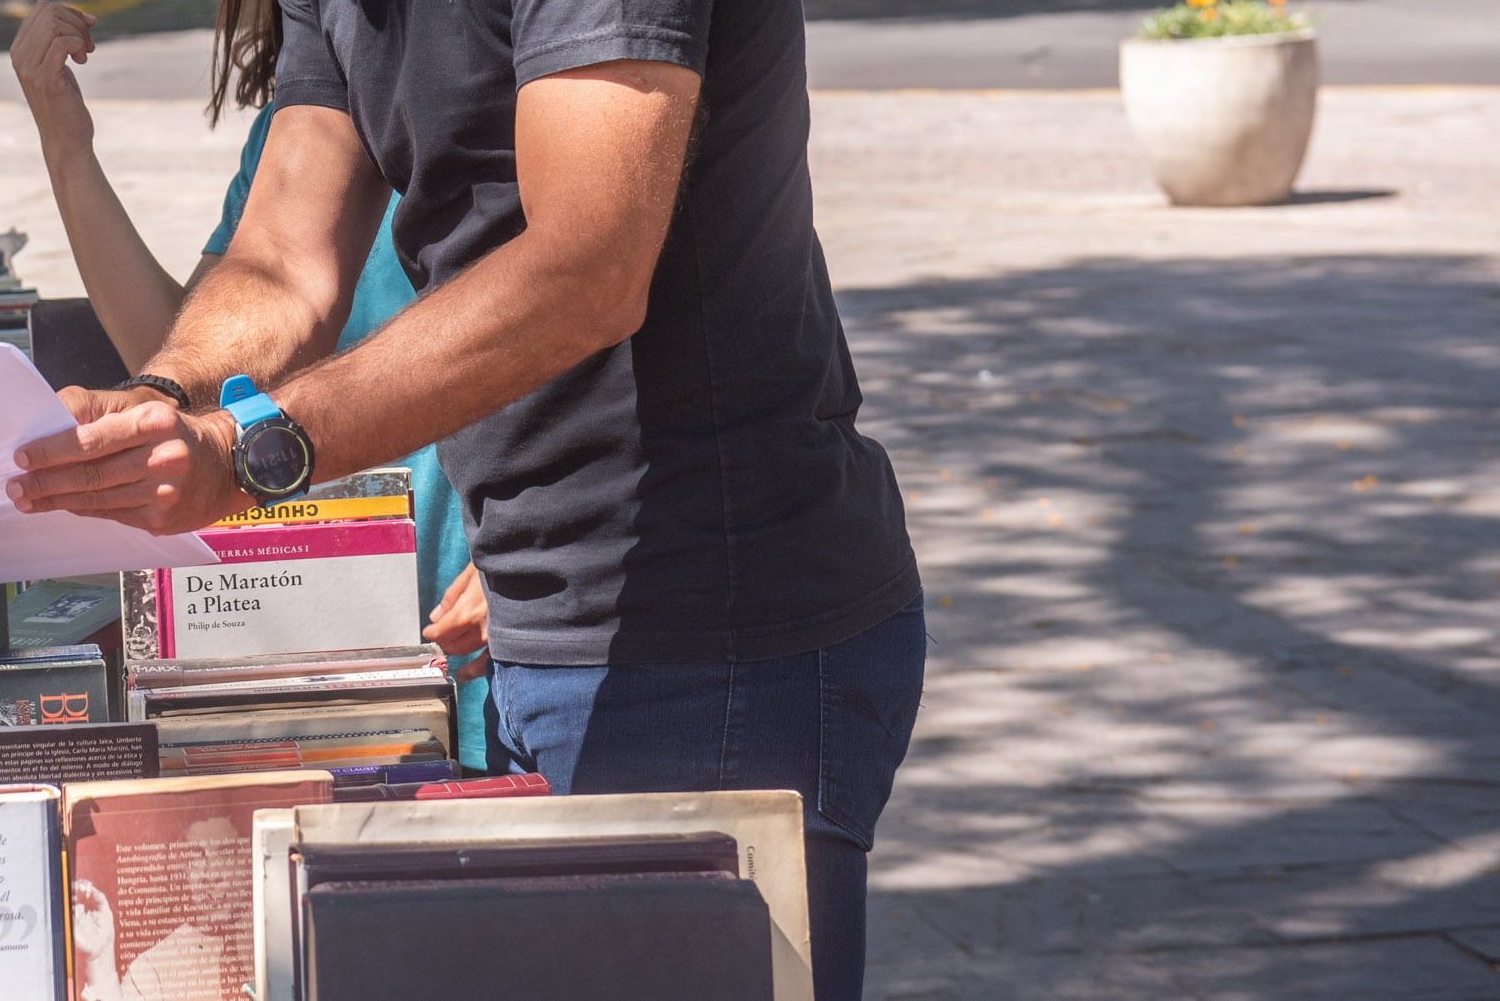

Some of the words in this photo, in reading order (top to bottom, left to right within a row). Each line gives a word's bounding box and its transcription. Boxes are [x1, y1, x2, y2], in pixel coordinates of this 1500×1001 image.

[216, 548, 254, 558] UERRAS
[257, 545, 303, 556] MÉDICAS
[305, 545, 310, 553] I
[186, 574, 213, 594] De
[219, 569, 304, 591] Maratón
[187, 601, 197, 615] a
[203, 594, 262, 615] Platea
[187, 621, 211, 632] Philip
[211, 620, 221, 630] de
[222, 618, 246, 629] Souza
[0, 889, 9, 902] él
